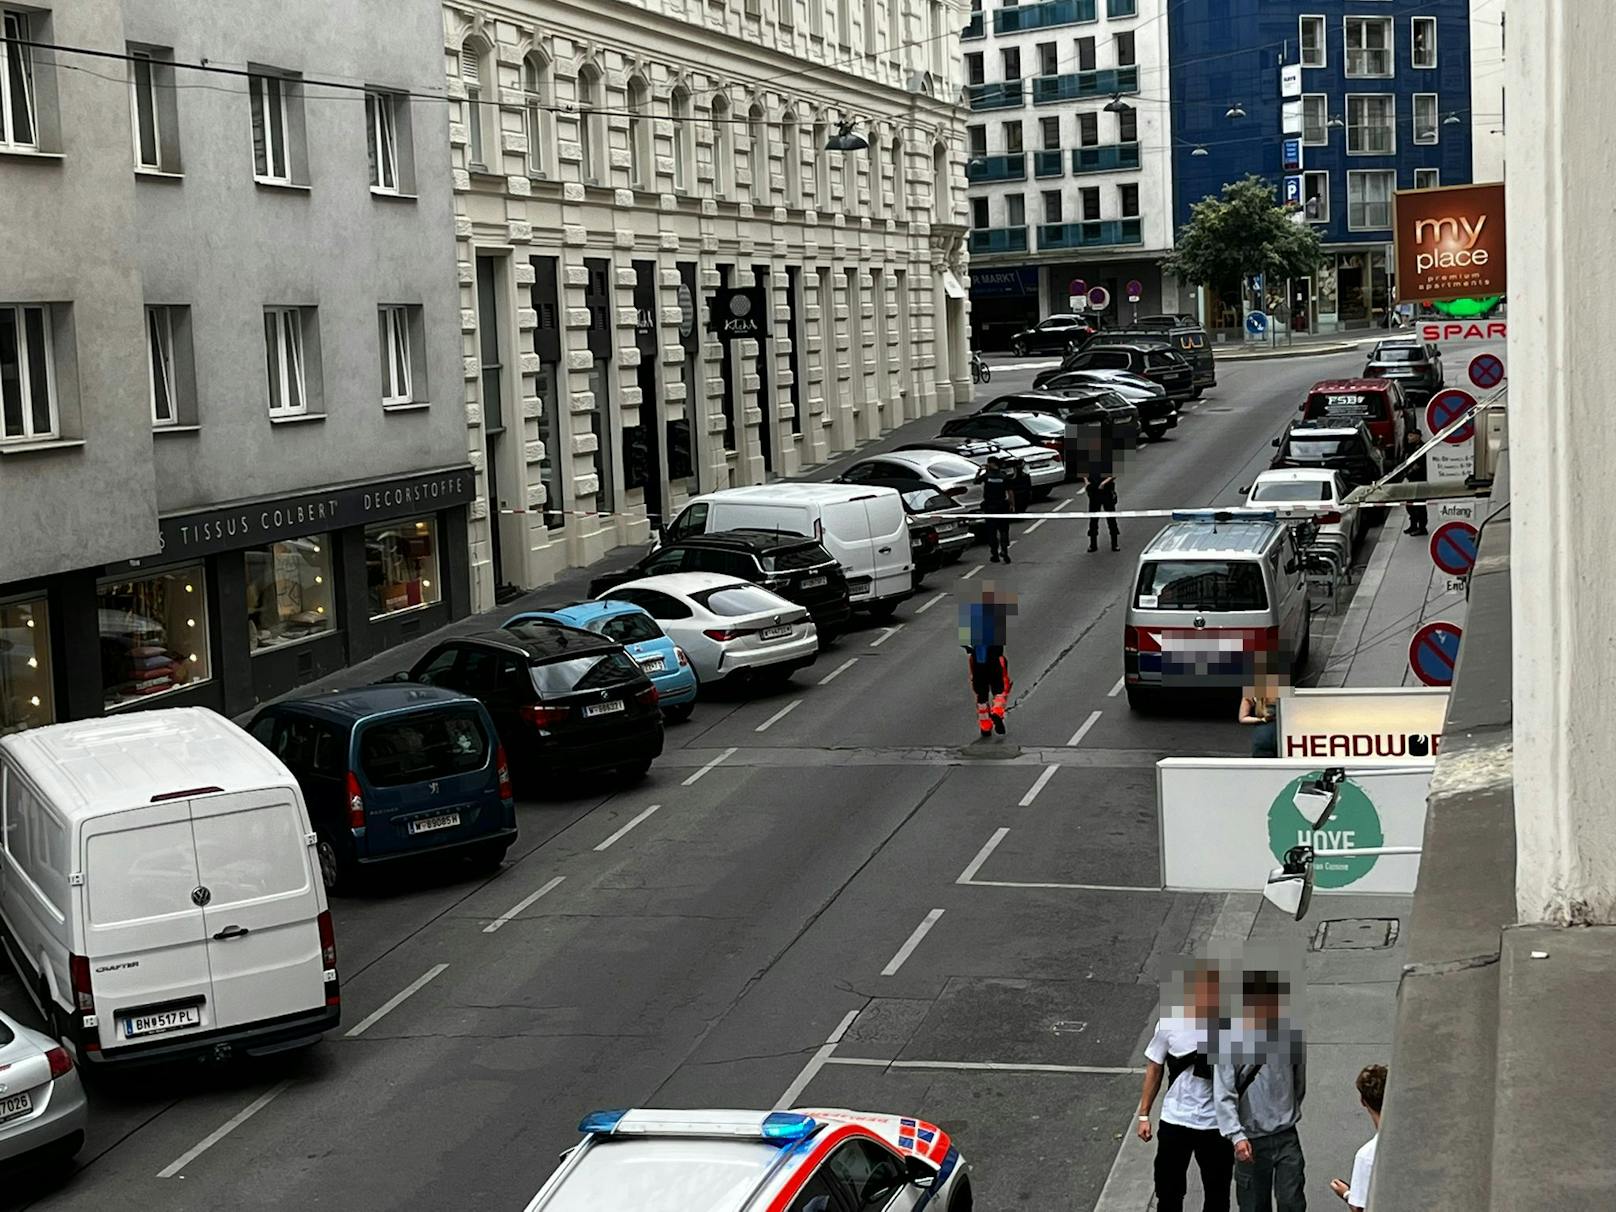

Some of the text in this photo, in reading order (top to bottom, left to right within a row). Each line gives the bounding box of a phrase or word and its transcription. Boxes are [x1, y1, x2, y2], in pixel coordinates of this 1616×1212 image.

[1415, 215, 1487, 249] my
[1416, 249, 1489, 274] place
[1418, 279, 1490, 290] apartments
[1428, 273, 1480, 283] premium
[1423, 323, 1506, 341] SPAR
[181, 516, 249, 544] TISSUS
[261, 501, 336, 529] COLBERT
[364, 481, 463, 511] DECORSTOFFE
[1441, 505, 1471, 518] Anfang
[136, 1017, 151, 1031] BN
[159, 1012, 177, 1027] 517
[179, 1010, 193, 1023] PL
